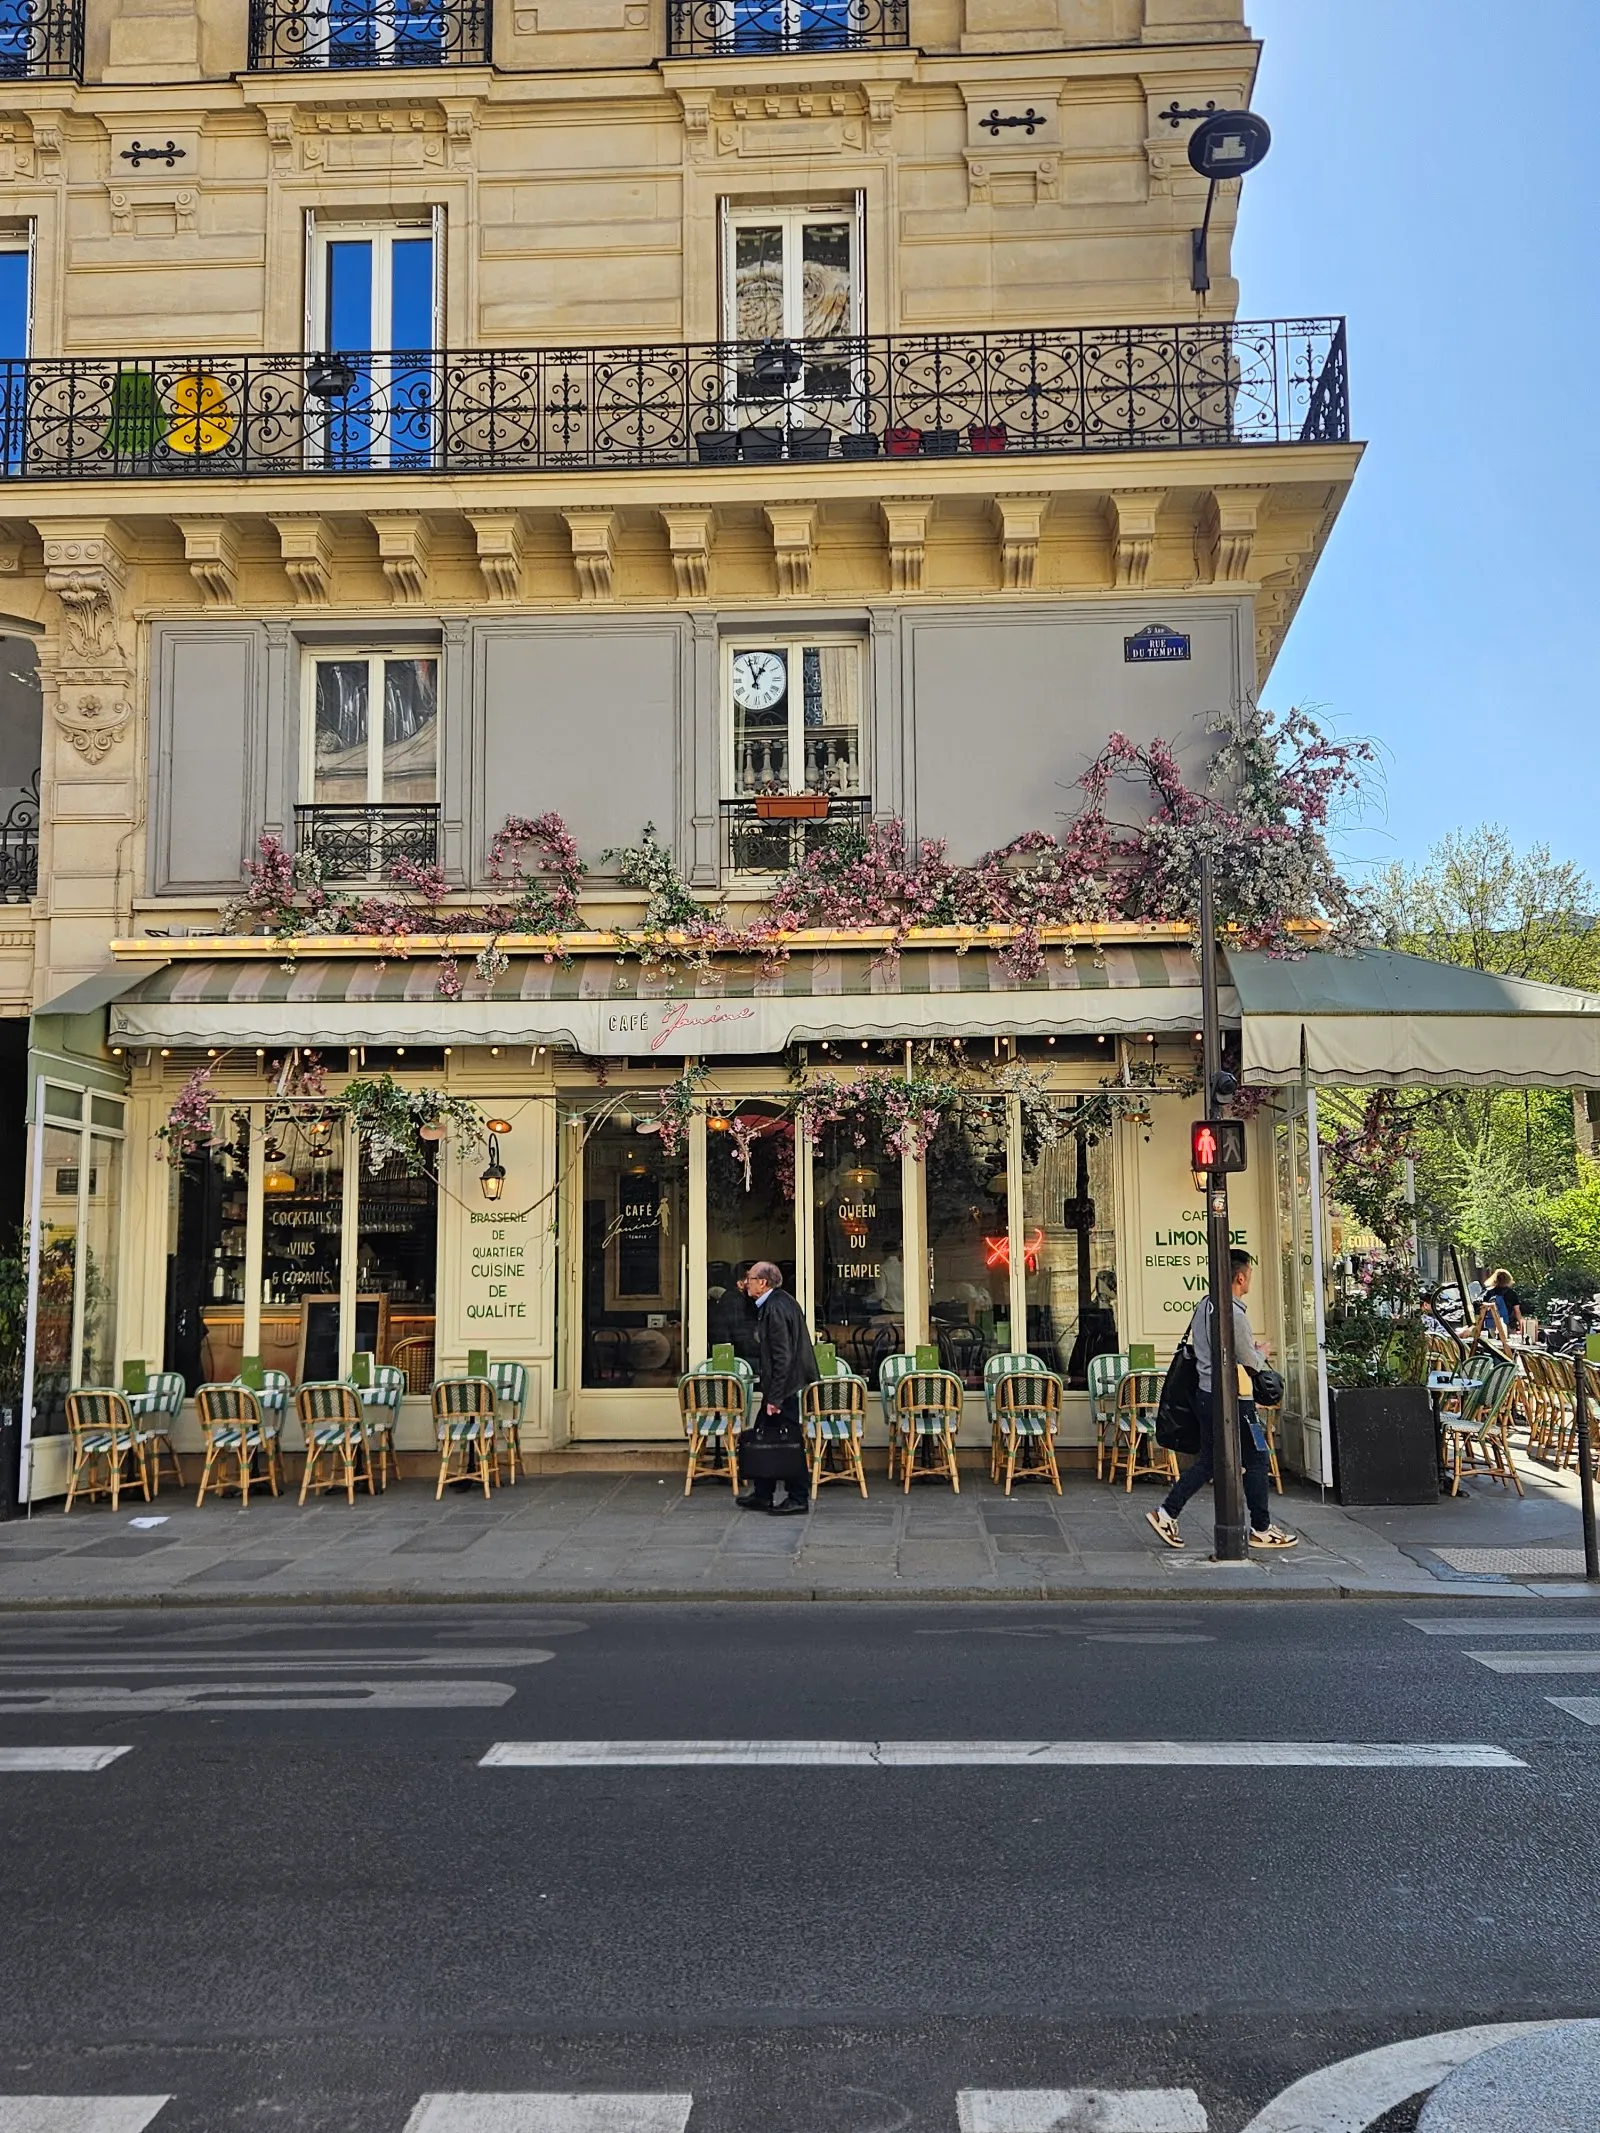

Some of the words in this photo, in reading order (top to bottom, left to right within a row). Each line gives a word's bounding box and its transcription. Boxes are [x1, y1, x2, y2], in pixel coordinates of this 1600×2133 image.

[1149, 639, 1167, 648] RUE
[1132, 649, 1145, 658] DU
[1148, 647, 1184, 657] TEMPLE
[609, 1012, 648, 1031] CAFÉ
[651, 1003, 755, 1051] Janine
[625, 1202, 652, 1217] CAFÉ
[838, 1204, 876, 1220] QUEEN
[1182, 1211, 1208, 1221] CAF
[272, 1211, 332, 1226] COCKTAILS
[492, 1230, 505, 1240] DE
[602, 1214, 661, 1249] Janine
[290, 1242, 315, 1255] VINS
[850, 1235, 866, 1249] DU
[473, 1246, 524, 1259] QUARTIER
[471, 1262, 525, 1277] CUISINE
[837, 1264, 881, 1278] TEMPLE
[272, 1271, 279, 1285] &
[283, 1271, 331, 1285] COPAINS
[1182, 1274, 1211, 1291] VIN
[489, 1285, 507, 1297] DE
[467, 1302, 527, 1319] QUALITÉ
